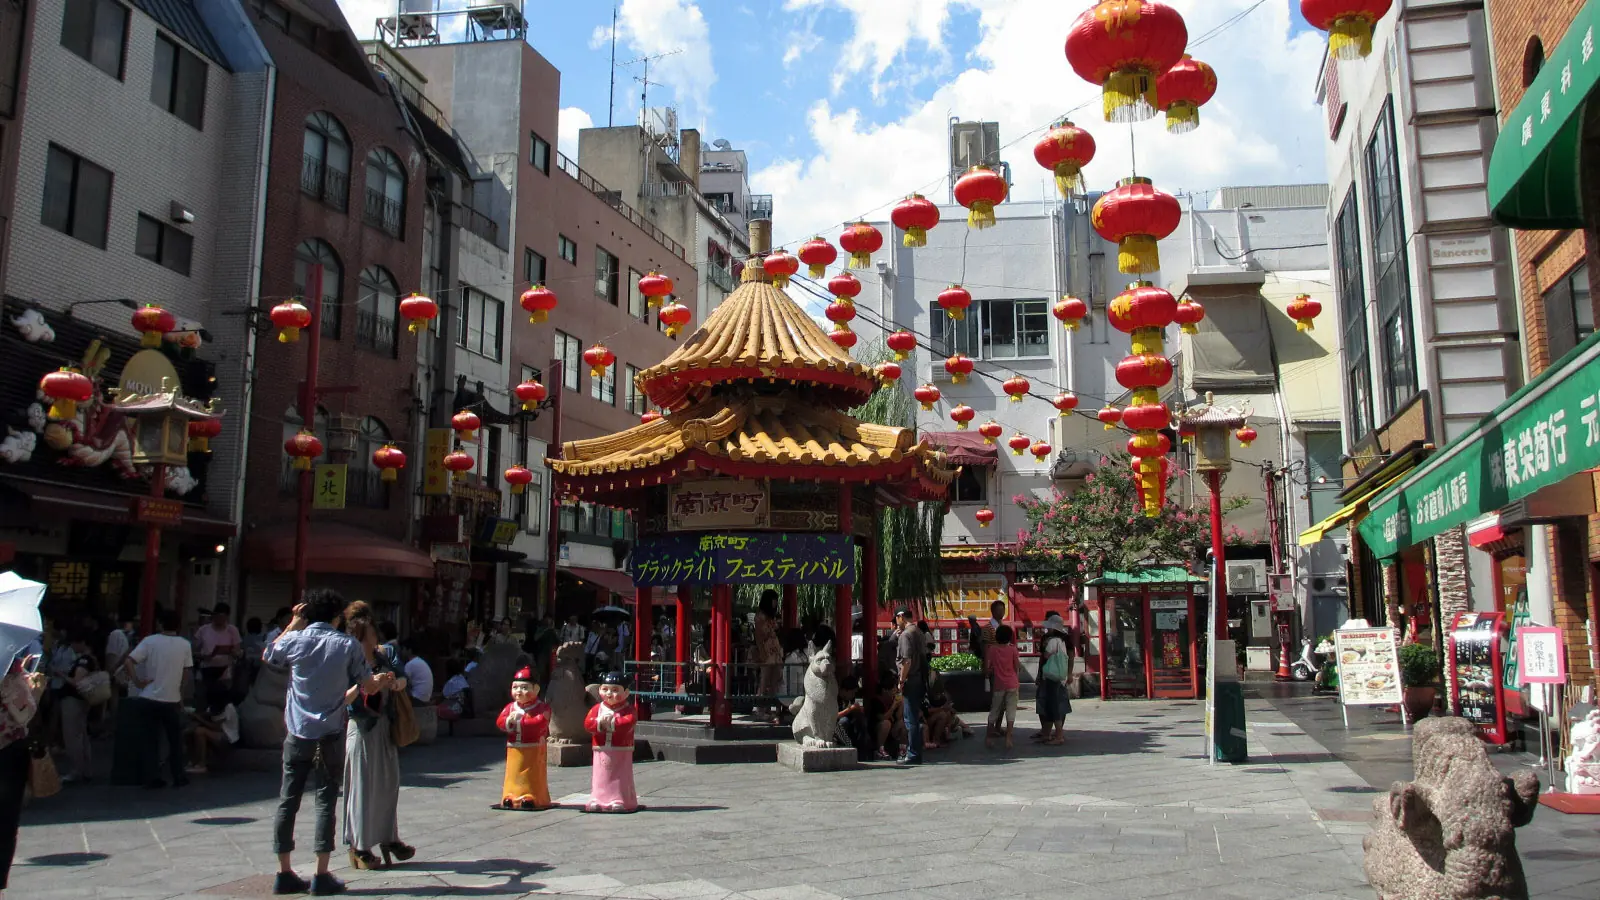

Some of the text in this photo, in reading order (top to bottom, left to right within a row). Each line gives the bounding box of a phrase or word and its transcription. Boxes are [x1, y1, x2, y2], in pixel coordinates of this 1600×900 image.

[1433, 248, 1488, 258] Sancerre
[674, 491, 764, 516] 南京町
[699, 534, 749, 551] 南京町
[637, 556, 849, 582] ブラックライト フェスティバル
